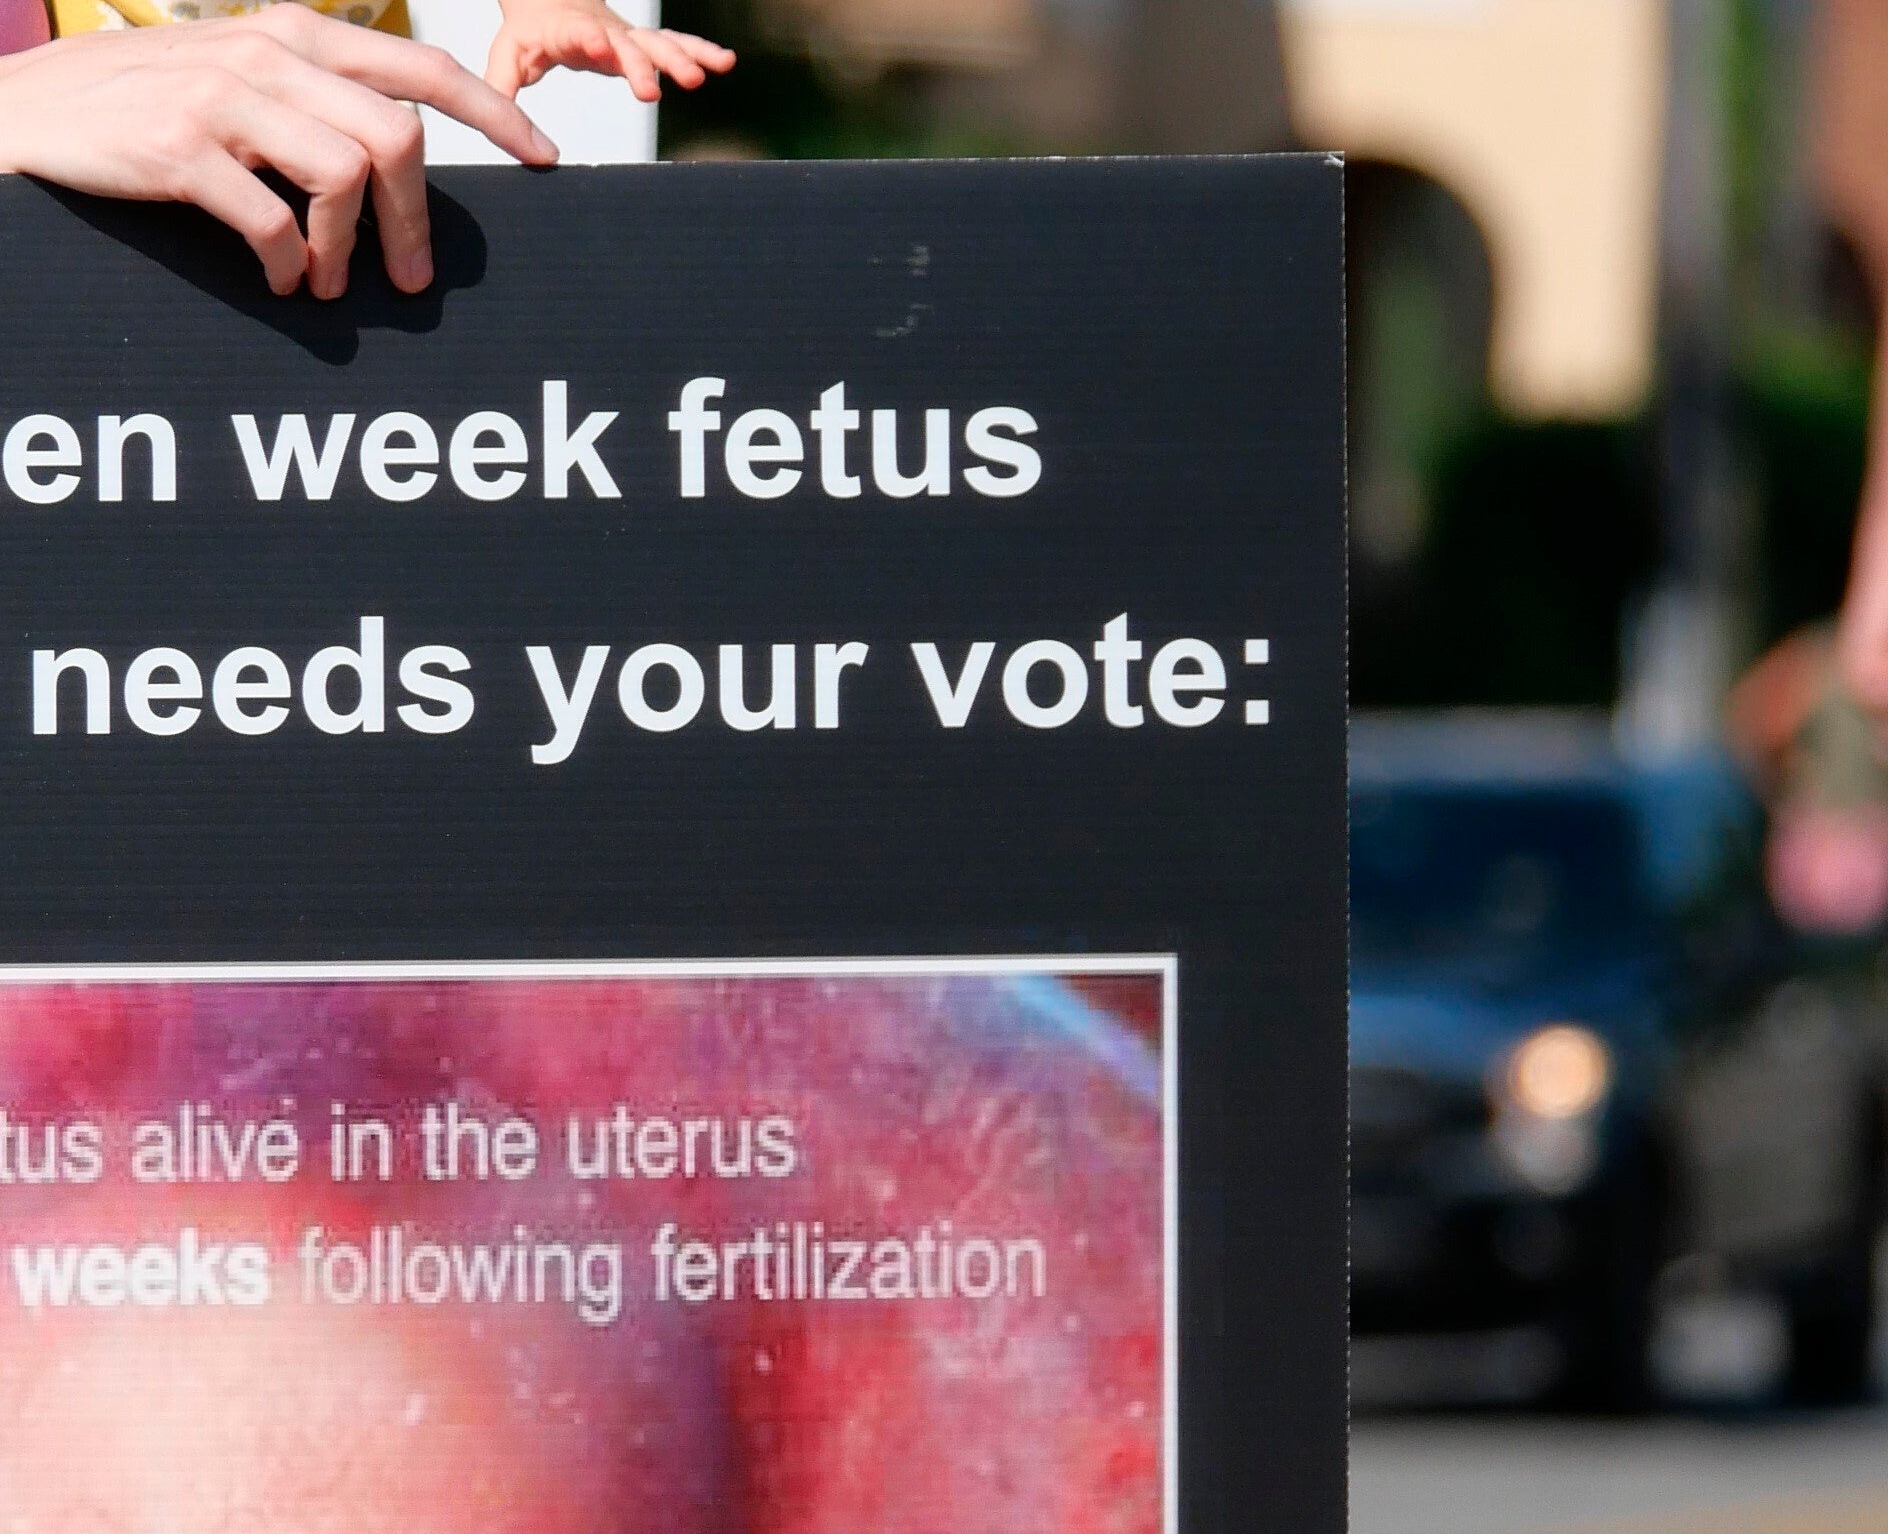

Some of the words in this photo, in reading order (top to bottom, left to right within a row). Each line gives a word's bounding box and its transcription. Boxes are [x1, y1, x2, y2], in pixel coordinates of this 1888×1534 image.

[231, 380, 622, 501] week
[668, 377, 1041, 499] fetus
[33, 616, 474, 735] needs
[526, 642, 869, 764] your
[911, 613, 1269, 728] vote:
[131, 1101, 299, 1183] alive
[330, 1102, 393, 1181] in
[422, 1102, 539, 1180] the
[567, 1104, 797, 1177] uterus
[11, 1226, 273, 1308] weeks
[299, 1225, 621, 1325] following
[651, 1222, 1046, 1301] fertilization
